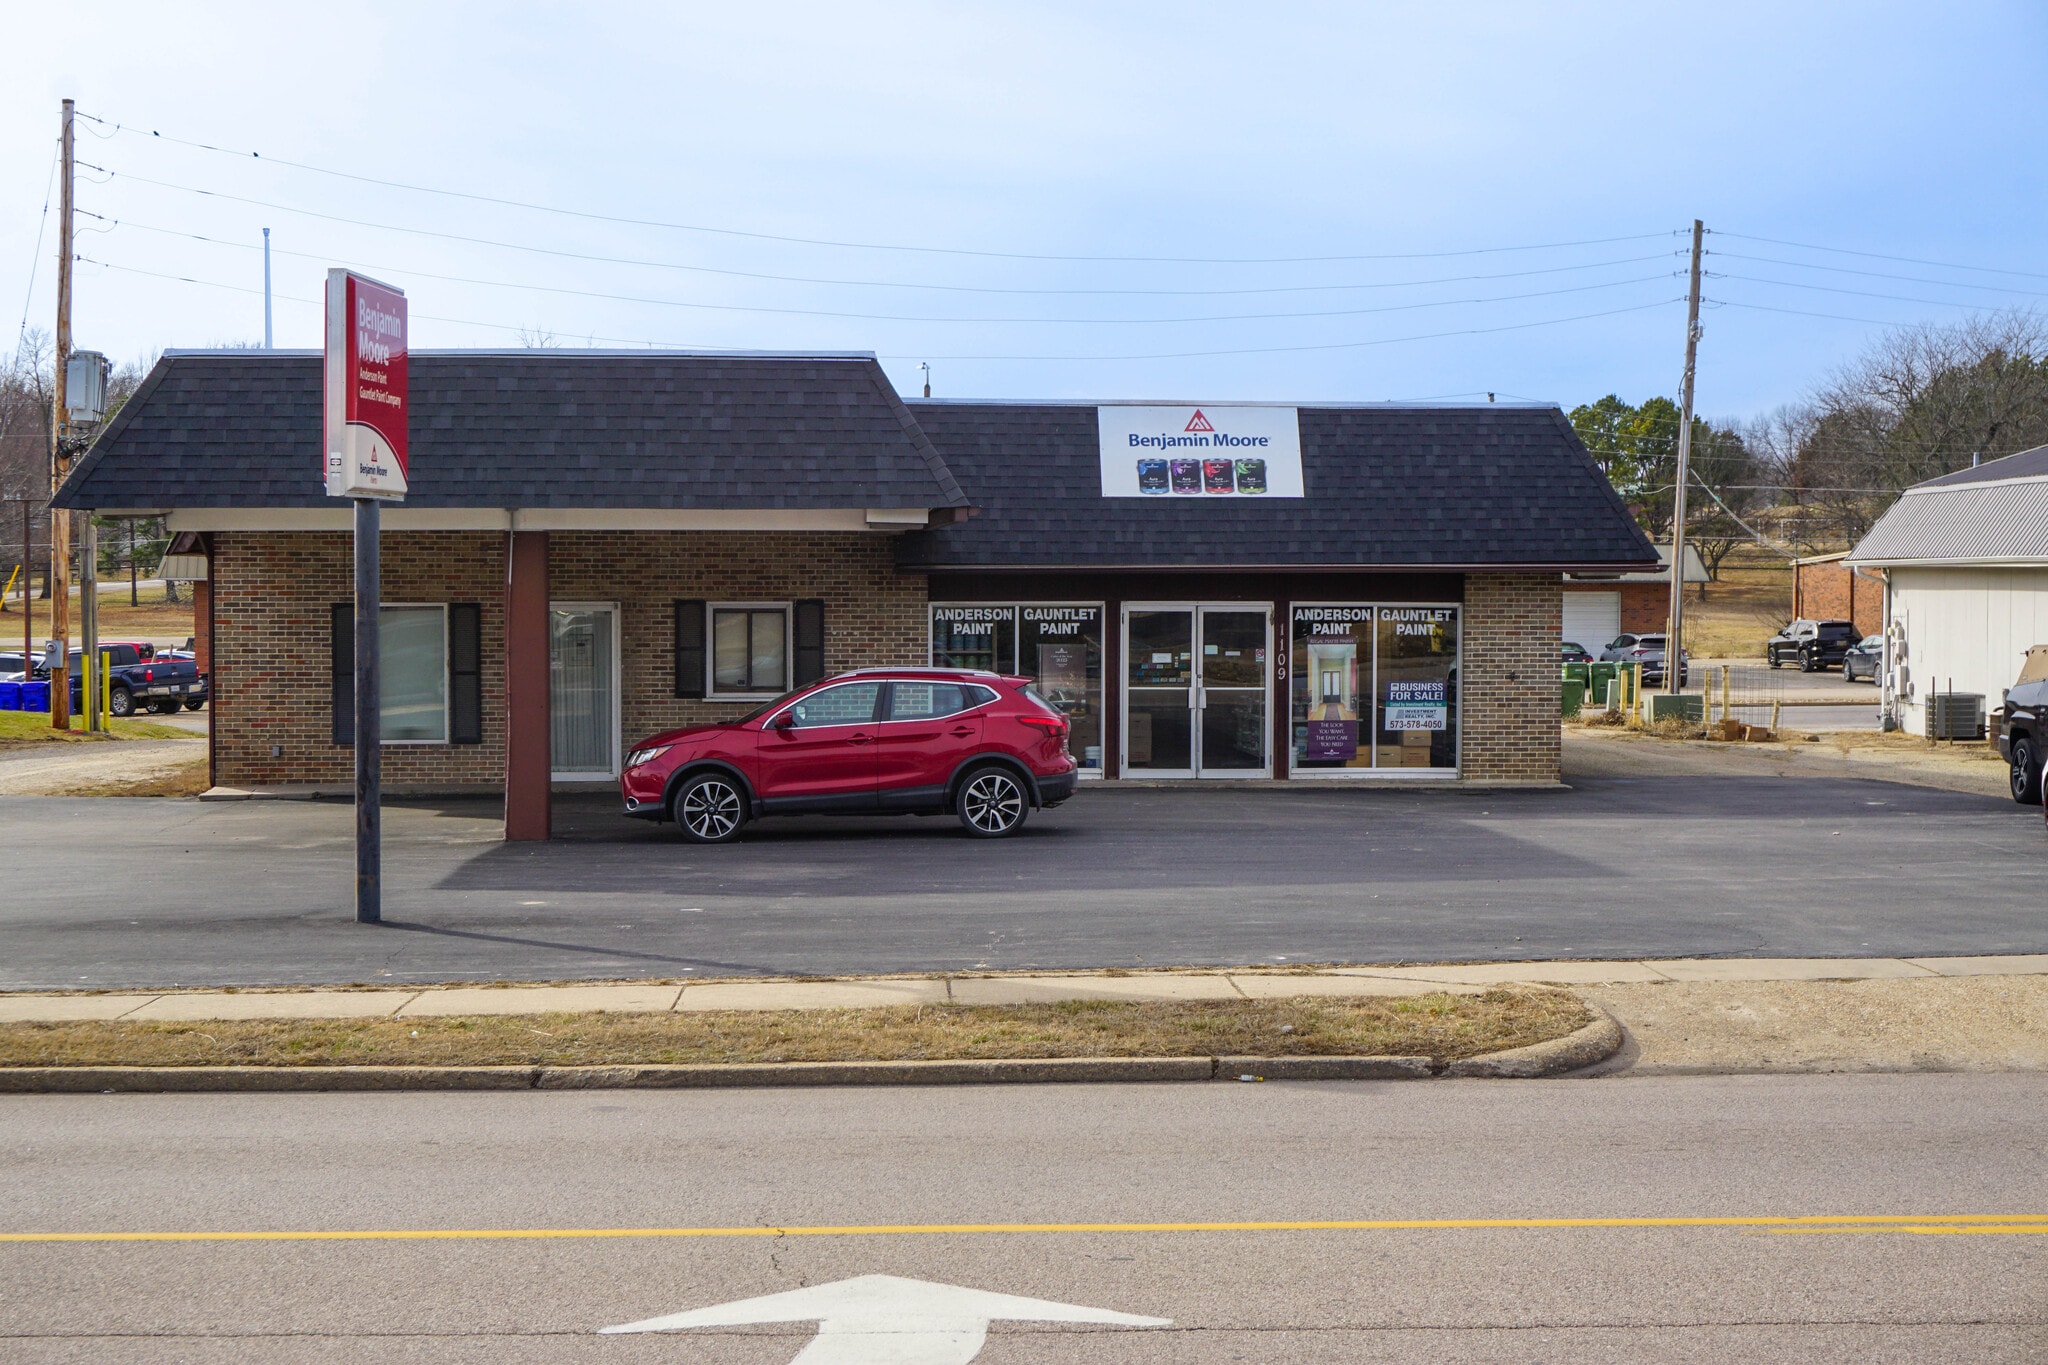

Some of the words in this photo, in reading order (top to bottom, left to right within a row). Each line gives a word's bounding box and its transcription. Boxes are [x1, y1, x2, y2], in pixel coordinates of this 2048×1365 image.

[359, 297, 401, 340] Benjamin
[359, 330, 390, 366] Moore
[359, 366, 378, 383] Anderson
[377, 370, 388, 385] Paint
[1128, 433, 1210, 450] Benjamin
[1213, 433, 1269, 447] Moore
[360, 463, 377, 477] Benjamin
[935, 608, 1013, 621] ANDERSON
[1024, 608, 1097, 621] GAUNTLET
[1294, 609, 1371, 621] ANDERSON
[1380, 609, 1452, 622] GAUNTLET
[953, 622, 994, 635] PAINT
[1040, 622, 1080, 635] PAINT
[1312, 623, 1352, 635] PAINT
[1396, 623, 1436, 636] PAINT
[1400, 682, 1444, 691] BUSINESS
[1390, 691, 1411, 701] FOR
[1414, 691, 1444, 701] SALE!
[1390, 720, 1443, 729] 573-578-4050
